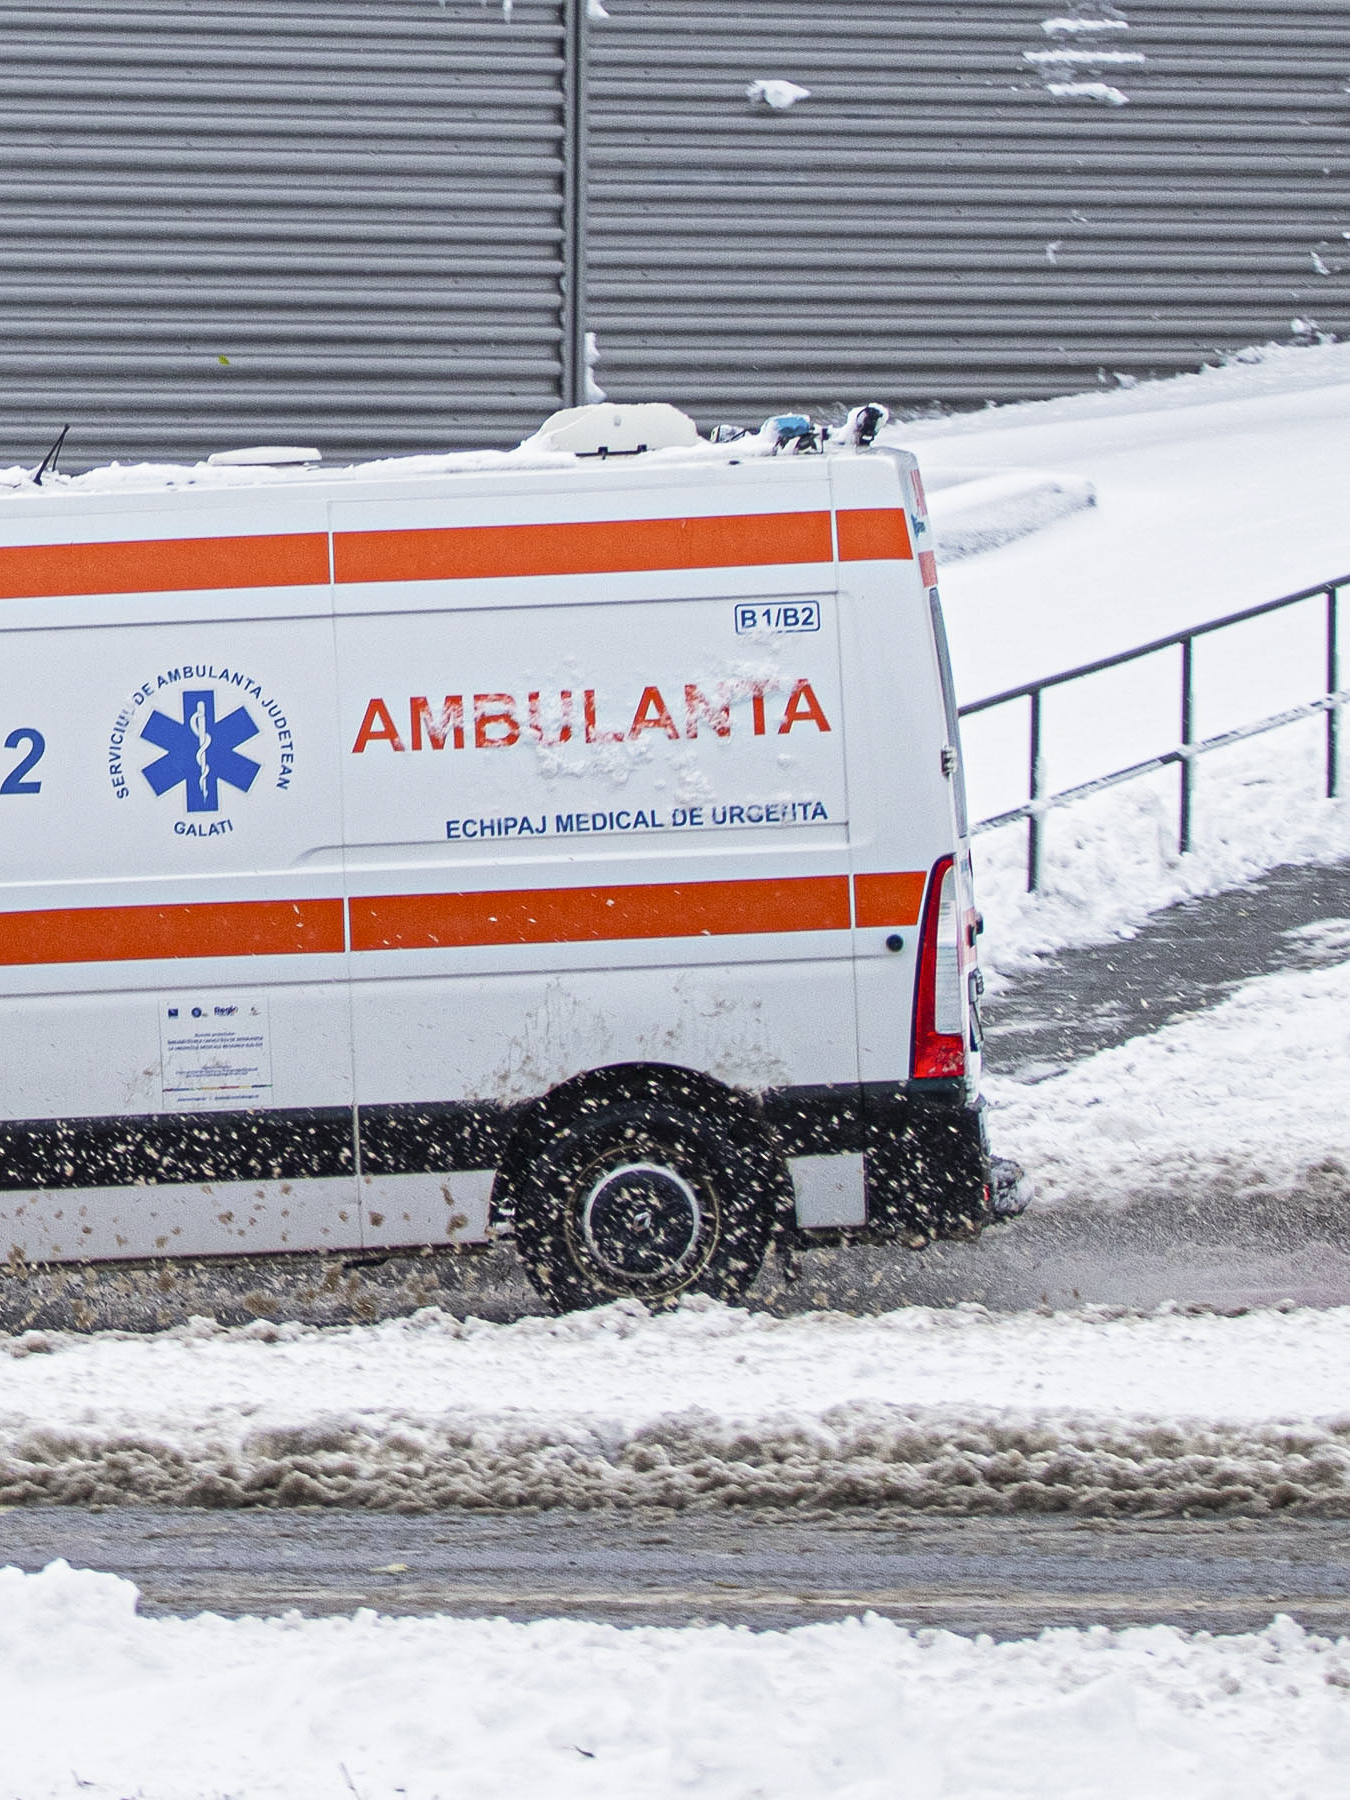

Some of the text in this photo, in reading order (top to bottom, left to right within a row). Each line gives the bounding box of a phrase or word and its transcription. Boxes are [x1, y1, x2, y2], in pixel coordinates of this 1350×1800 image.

[741, 607, 814, 628] B1/B2
[133, 682, 155, 705] DE
[157, 665, 262, 699] AMBULANTA
[261, 699, 294, 790] JUDETEAN
[352, 678, 831, 753] AMBULANTA
[174, 819, 234, 837] GALATI
[446, 815, 547, 839] ECHIPAJ
[555, 809, 664, 833] MEDICAL
[672, 807, 704, 827] DE
